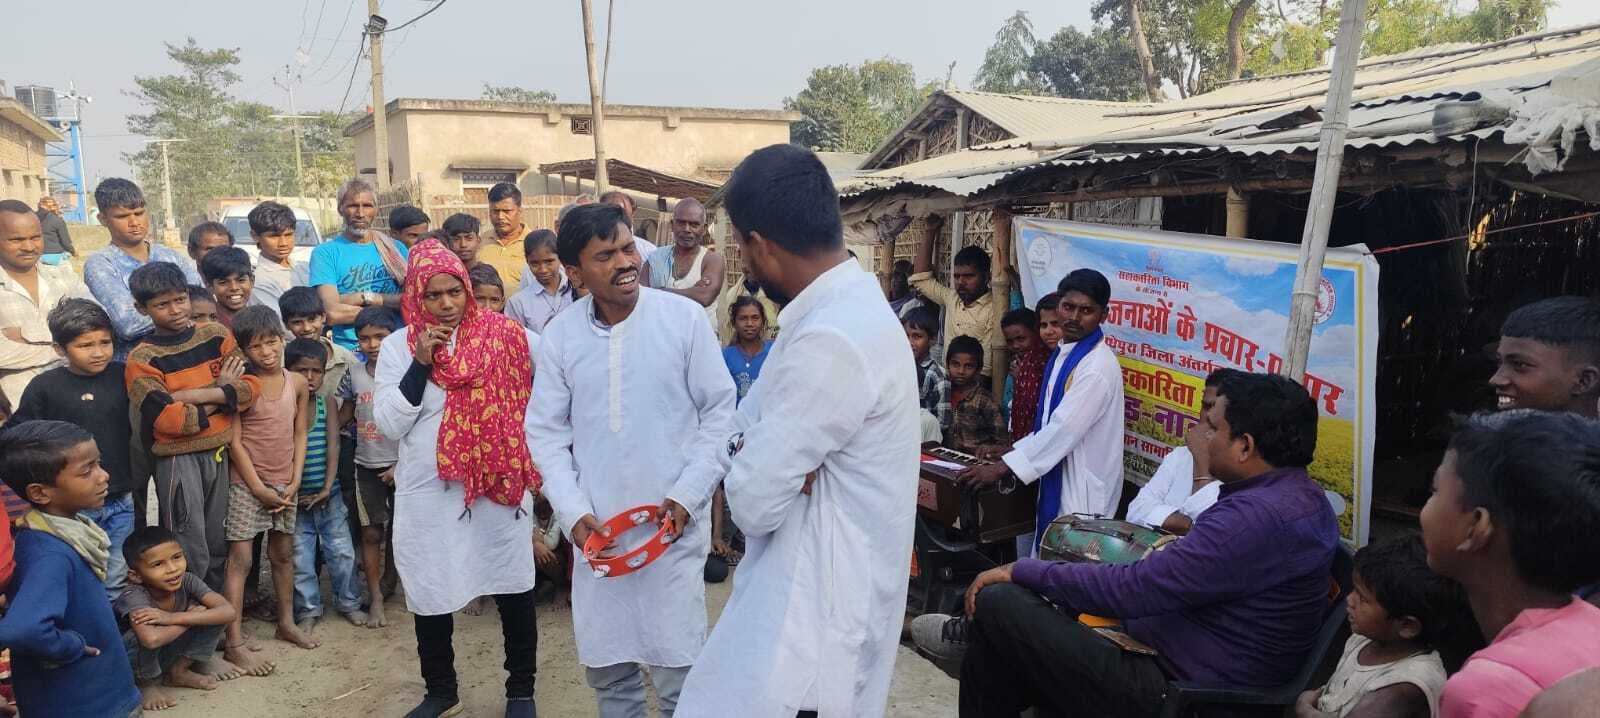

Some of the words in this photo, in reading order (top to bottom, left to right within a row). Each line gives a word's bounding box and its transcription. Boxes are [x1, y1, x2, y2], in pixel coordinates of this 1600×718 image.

[1162, 275, 1190, 292] विभाग
[1107, 298, 1174, 336] जनाओं
[1176, 305, 1198, 342] के
[1104, 335, 1138, 356] धेपुरा
[1141, 342, 1176, 365] जिला
[1179, 354, 1222, 375] अंतर्ग
[1121, 368, 1197, 407] हकारिता
